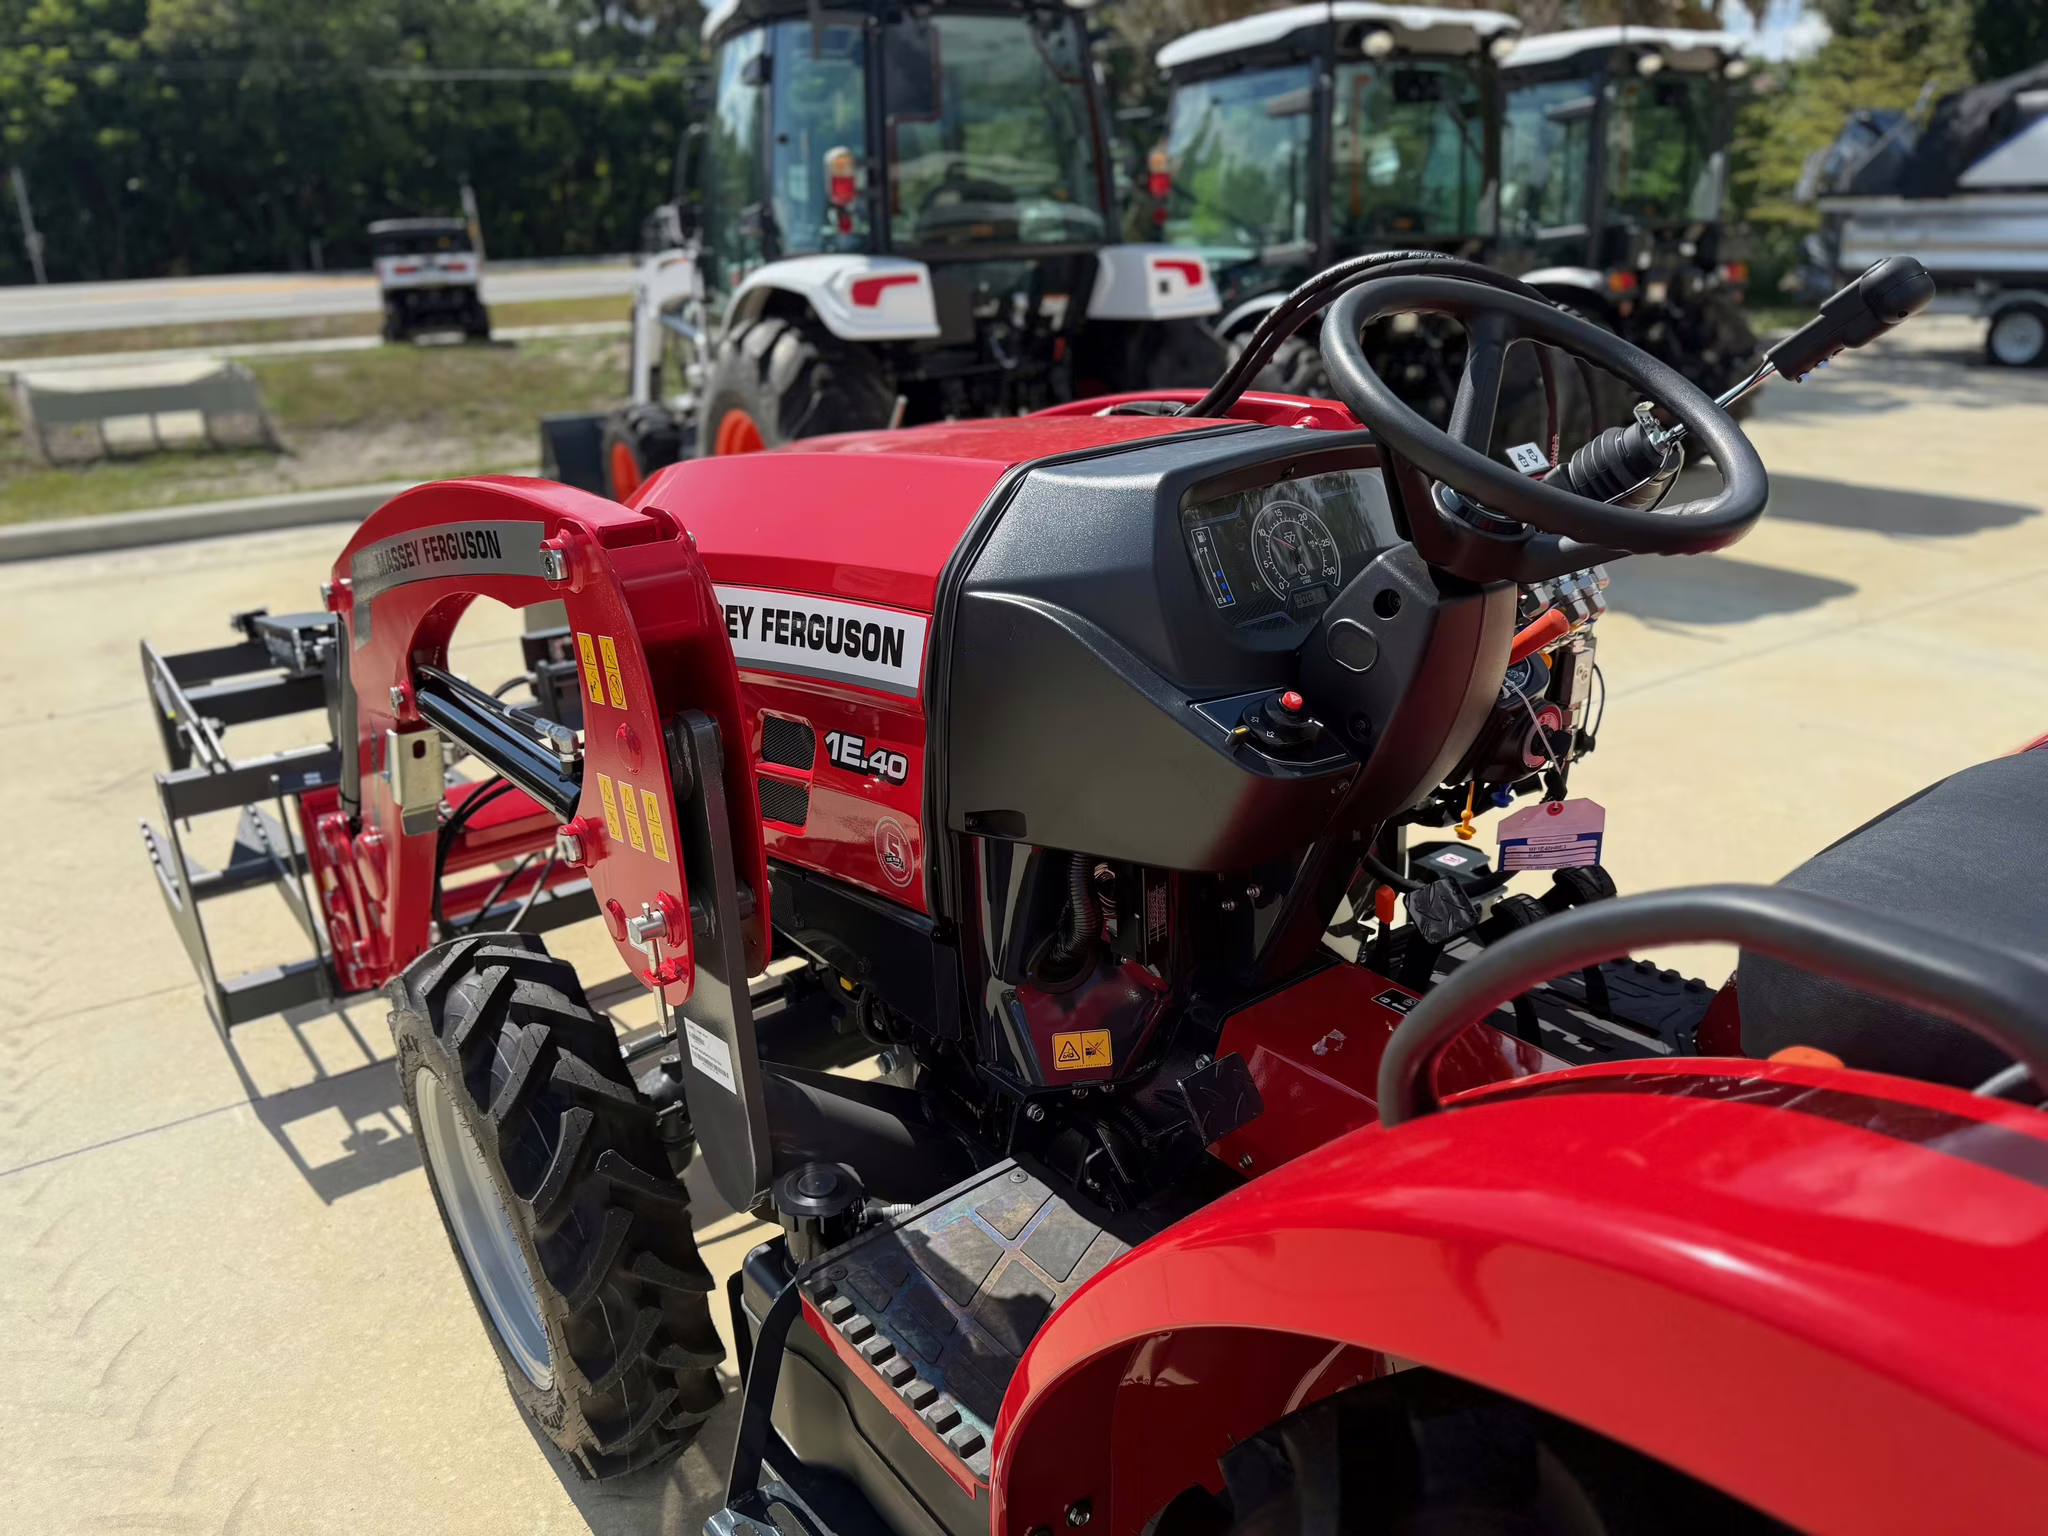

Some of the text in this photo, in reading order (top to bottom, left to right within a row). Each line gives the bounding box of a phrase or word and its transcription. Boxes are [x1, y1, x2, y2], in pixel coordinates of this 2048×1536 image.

[1388, 251, 1402, 260] PSI
[1274, 508, 1283, 518] 15
[1298, 512, 1308, 522] 20
[1258, 528, 1267, 537] 10
[1320, 538, 1331, 547] 25
[375, 530, 502, 577] MASSEY FERGUSON
[1263, 560, 1269, 569] 5
[1326, 566, 1336, 576] 30
[1251, 581, 1260, 591] N
[719, 604, 905, 668] EY FERGUSON
[825, 730, 907, 781] 1E.40
